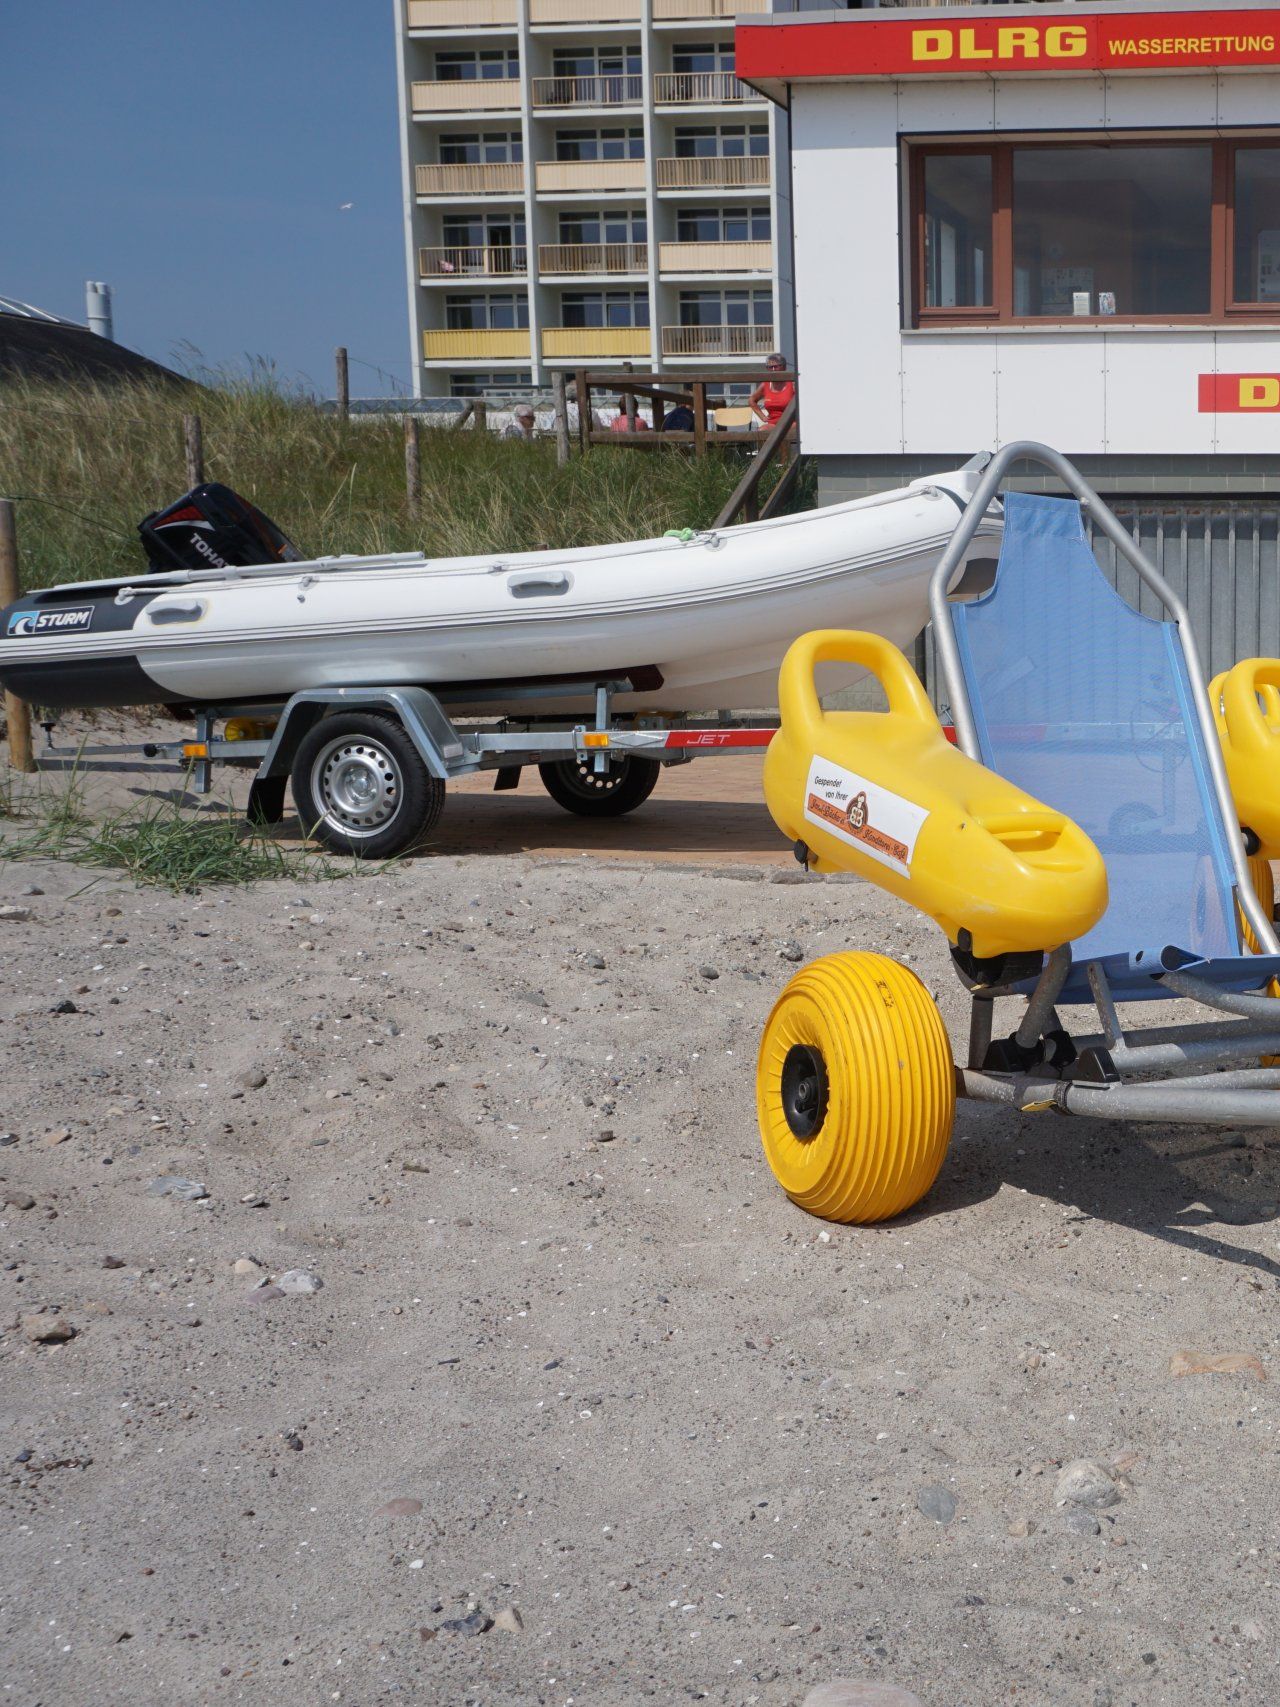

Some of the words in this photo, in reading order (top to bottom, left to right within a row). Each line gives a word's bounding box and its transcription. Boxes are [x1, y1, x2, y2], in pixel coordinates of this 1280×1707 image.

[911, 25, 1087, 61] DLRG
[1108, 34, 1276, 56] WASSERRETTUNG
[190, 532, 230, 568] TOHA
[36, 611, 90, 628] STURM
[686, 734, 731, 745] JET
[814, 776, 843, 788] Gespendet
[825, 791, 835, 799] von
[835, 791, 849, 801] Ihrer
